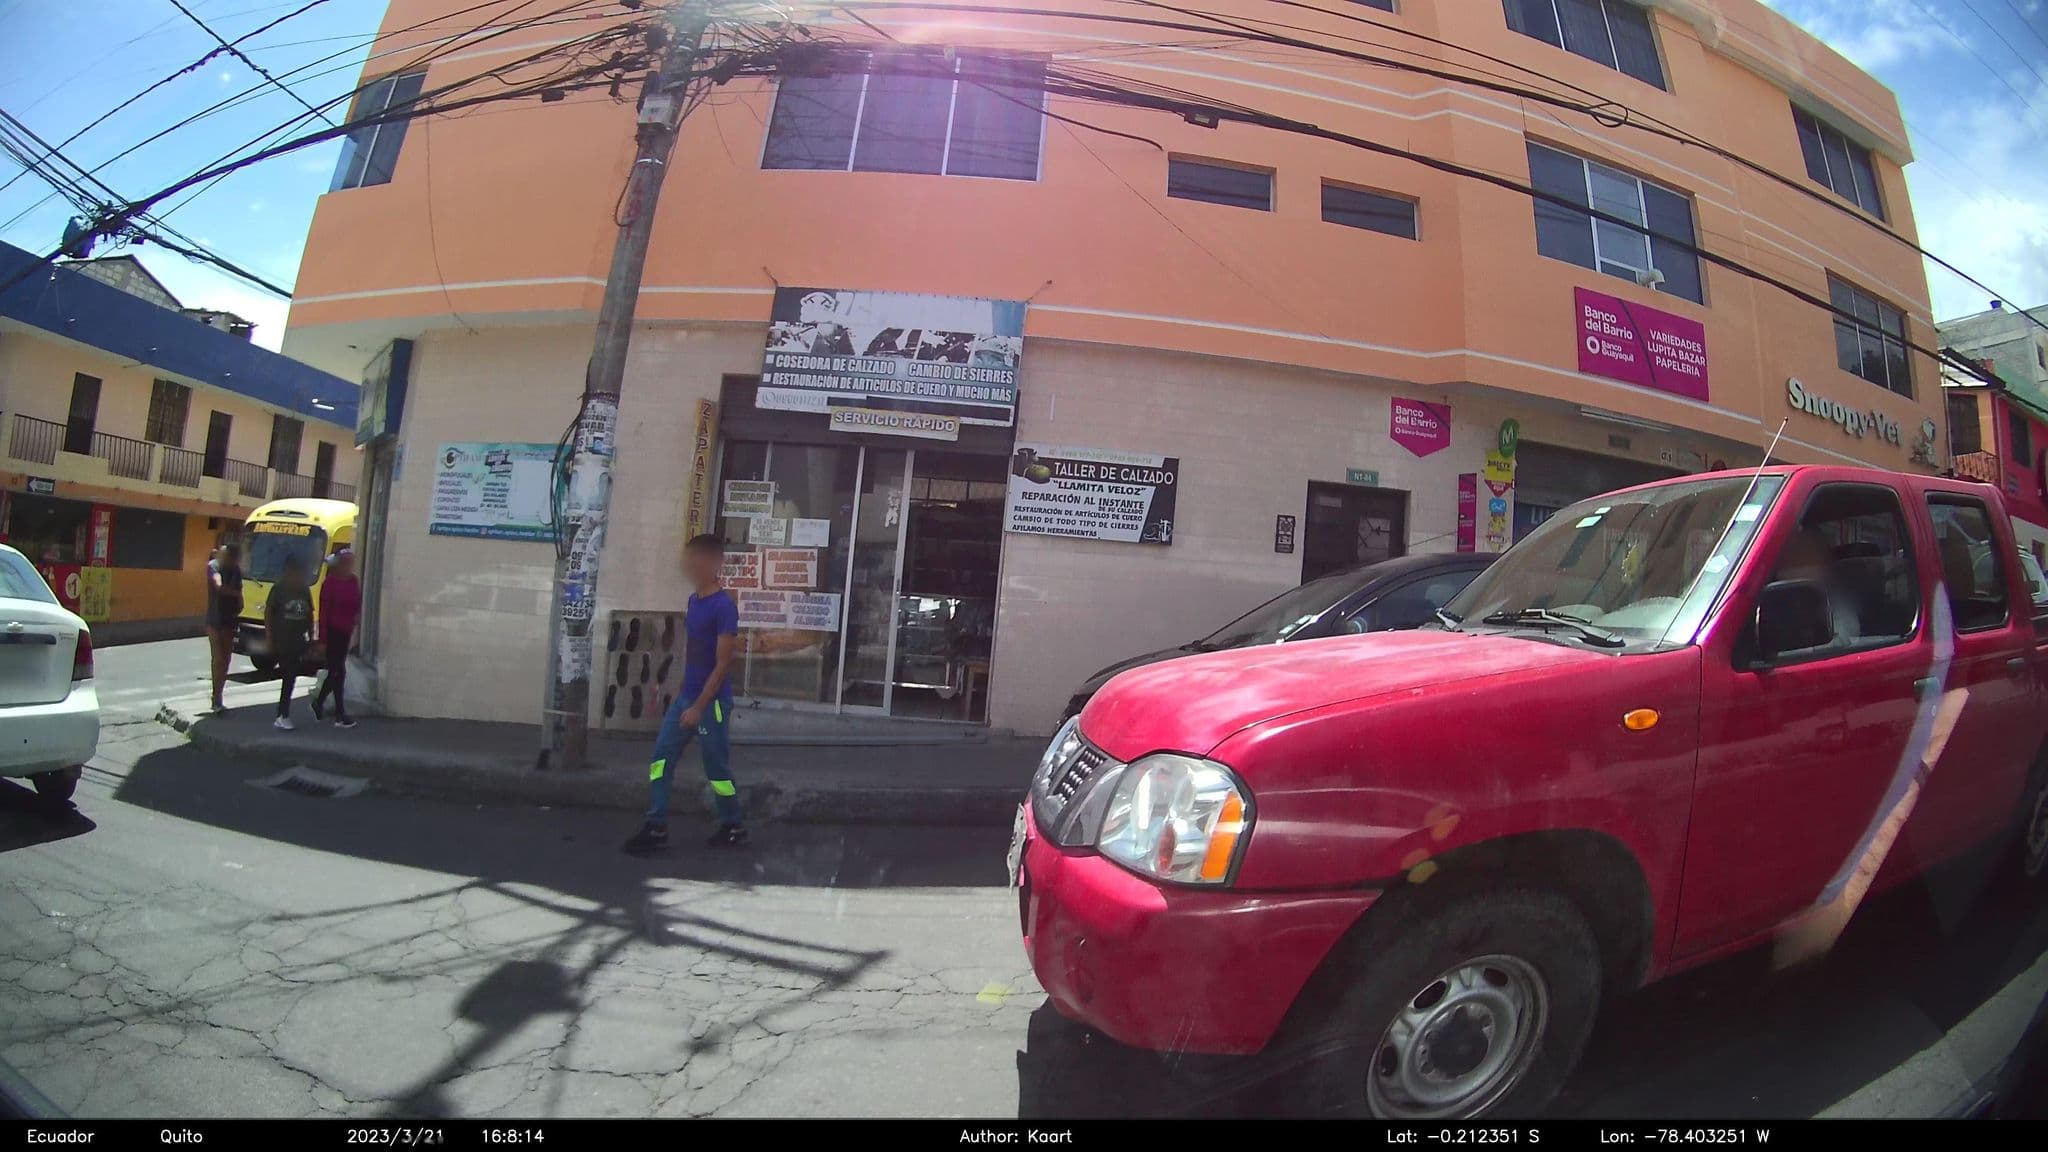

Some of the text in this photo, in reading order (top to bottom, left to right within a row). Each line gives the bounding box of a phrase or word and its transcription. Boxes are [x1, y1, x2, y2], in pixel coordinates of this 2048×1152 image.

[1584, 304, 1617, 323] Banco
[1585, 318, 1633, 340] del Barrio
[1601, 340, 1622, 352] Banco
[1650, 329, 1702, 353] VARIEDADES
[1601, 348, 1634, 362] Guayaquil
[1647, 341, 1706, 367] LUPITA BAZAR
[775, 354, 1014, 384] COSEDORA DE CALZADO CAMBIO DE SIERRES
[1655, 355, 1701, 377] PAPELERIA
[772, 372, 1012, 402] RESTAURACIÓN DE ARTICULOS DE CUERO Y MUCHO MÁS
[834, 411, 899, 427] SERVICIO
[1395, 405, 1424, 418] Banco
[1395, 415, 1437, 429] del Barrio
[689, 402, 712, 541] ZAPATERI
[1054, 462, 1174, 485] TALLER DE CALZADO
[1021, 490, 1145, 510] REPARACIÓN AL INSTANTE
[1013, 505, 1063, 516] RESTAURACIÓN
[1074, 510, 1110, 520] ARTÍCULOS
[1121, 514, 1143, 522] CUERO
[1117, 507, 1144, 515] CALZADO
[1012, 524, 1097, 537] AFILAMOS HERRAMIENTAS
[1013, 514, 1042, 524] CAMBIO
[1056, 518, 1077, 526] TODO
[1110, 523, 1138, 531] CIERRES
